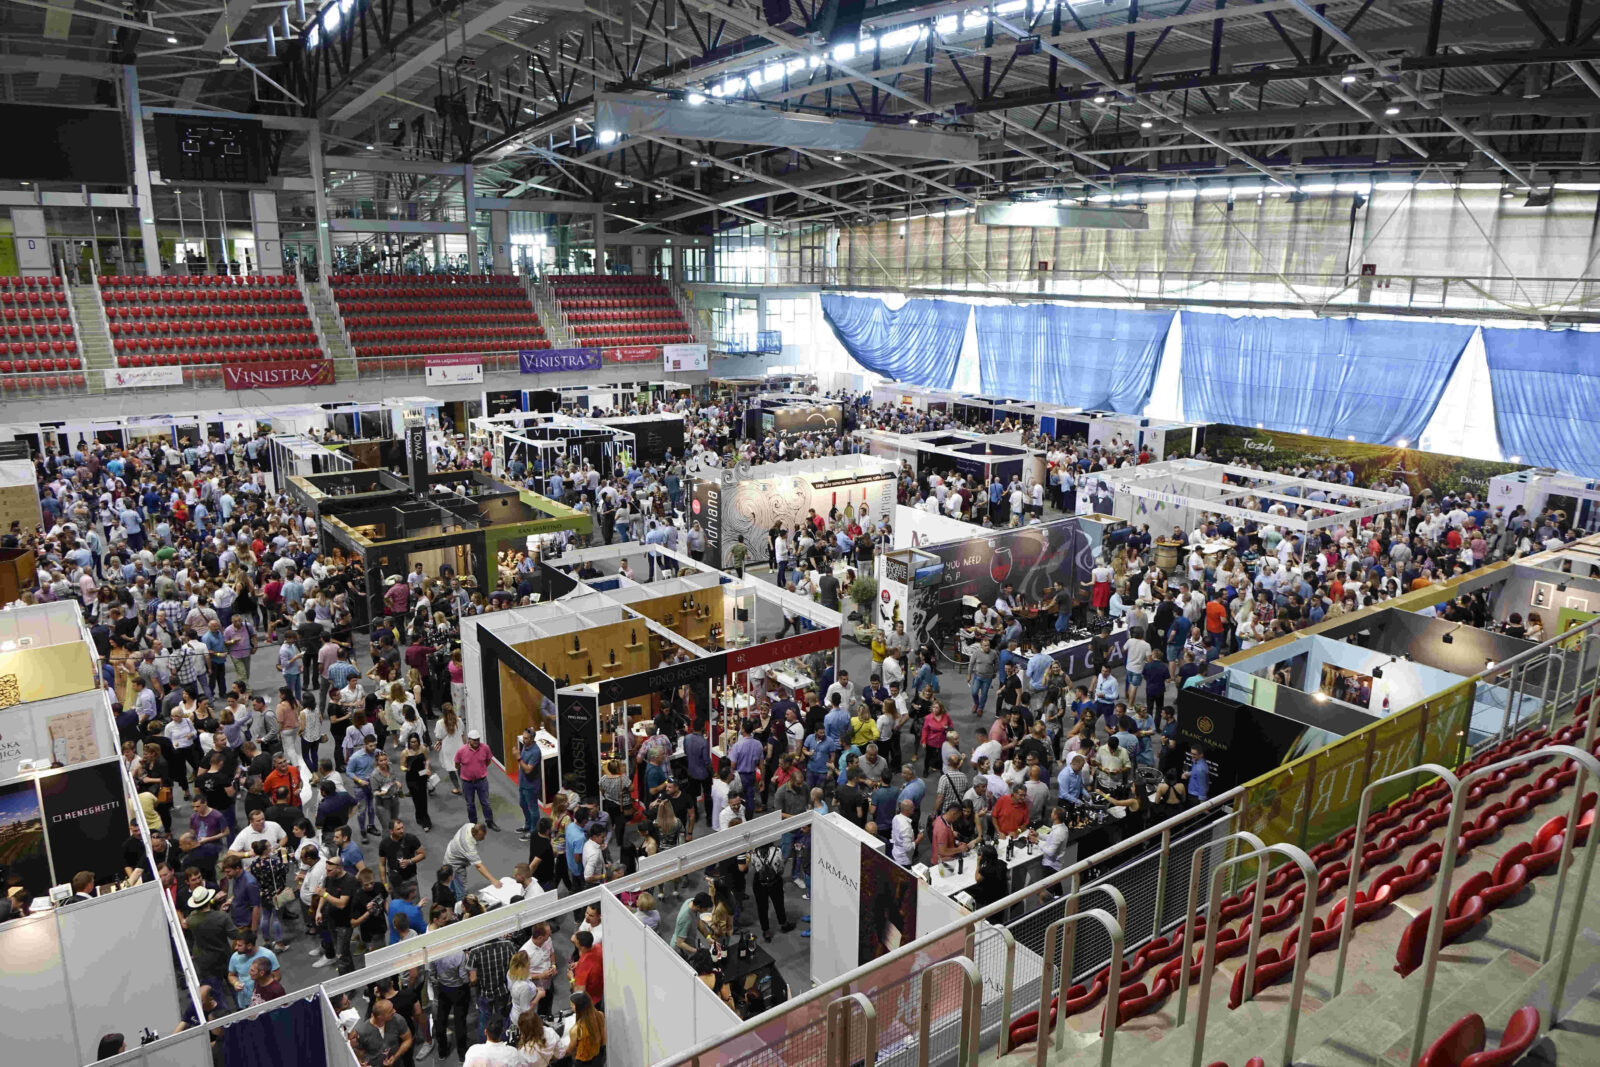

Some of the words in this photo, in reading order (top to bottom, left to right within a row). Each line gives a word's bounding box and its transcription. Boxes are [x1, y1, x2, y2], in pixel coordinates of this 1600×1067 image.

[28, 239, 37, 250] D
[264, 242, 271, 252] C
[522, 354, 586, 368] VINISTRA
[226, 366, 313, 383] VINISTRA
[413, 429, 423, 461] TOMAZ
[1120, 483, 1131, 494] 25
[1460, 475, 1490, 486] DAMJA
[705, 490, 718, 548] Adriana
[945, 561, 960, 570] YOU
[963, 555, 983, 567] NEED
[649, 671, 675, 688] PINO
[677, 663, 707, 680] ROSSI
[65, 801, 120, 820] MENEGHETTI
[818, 857, 859, 891] ARMAN
